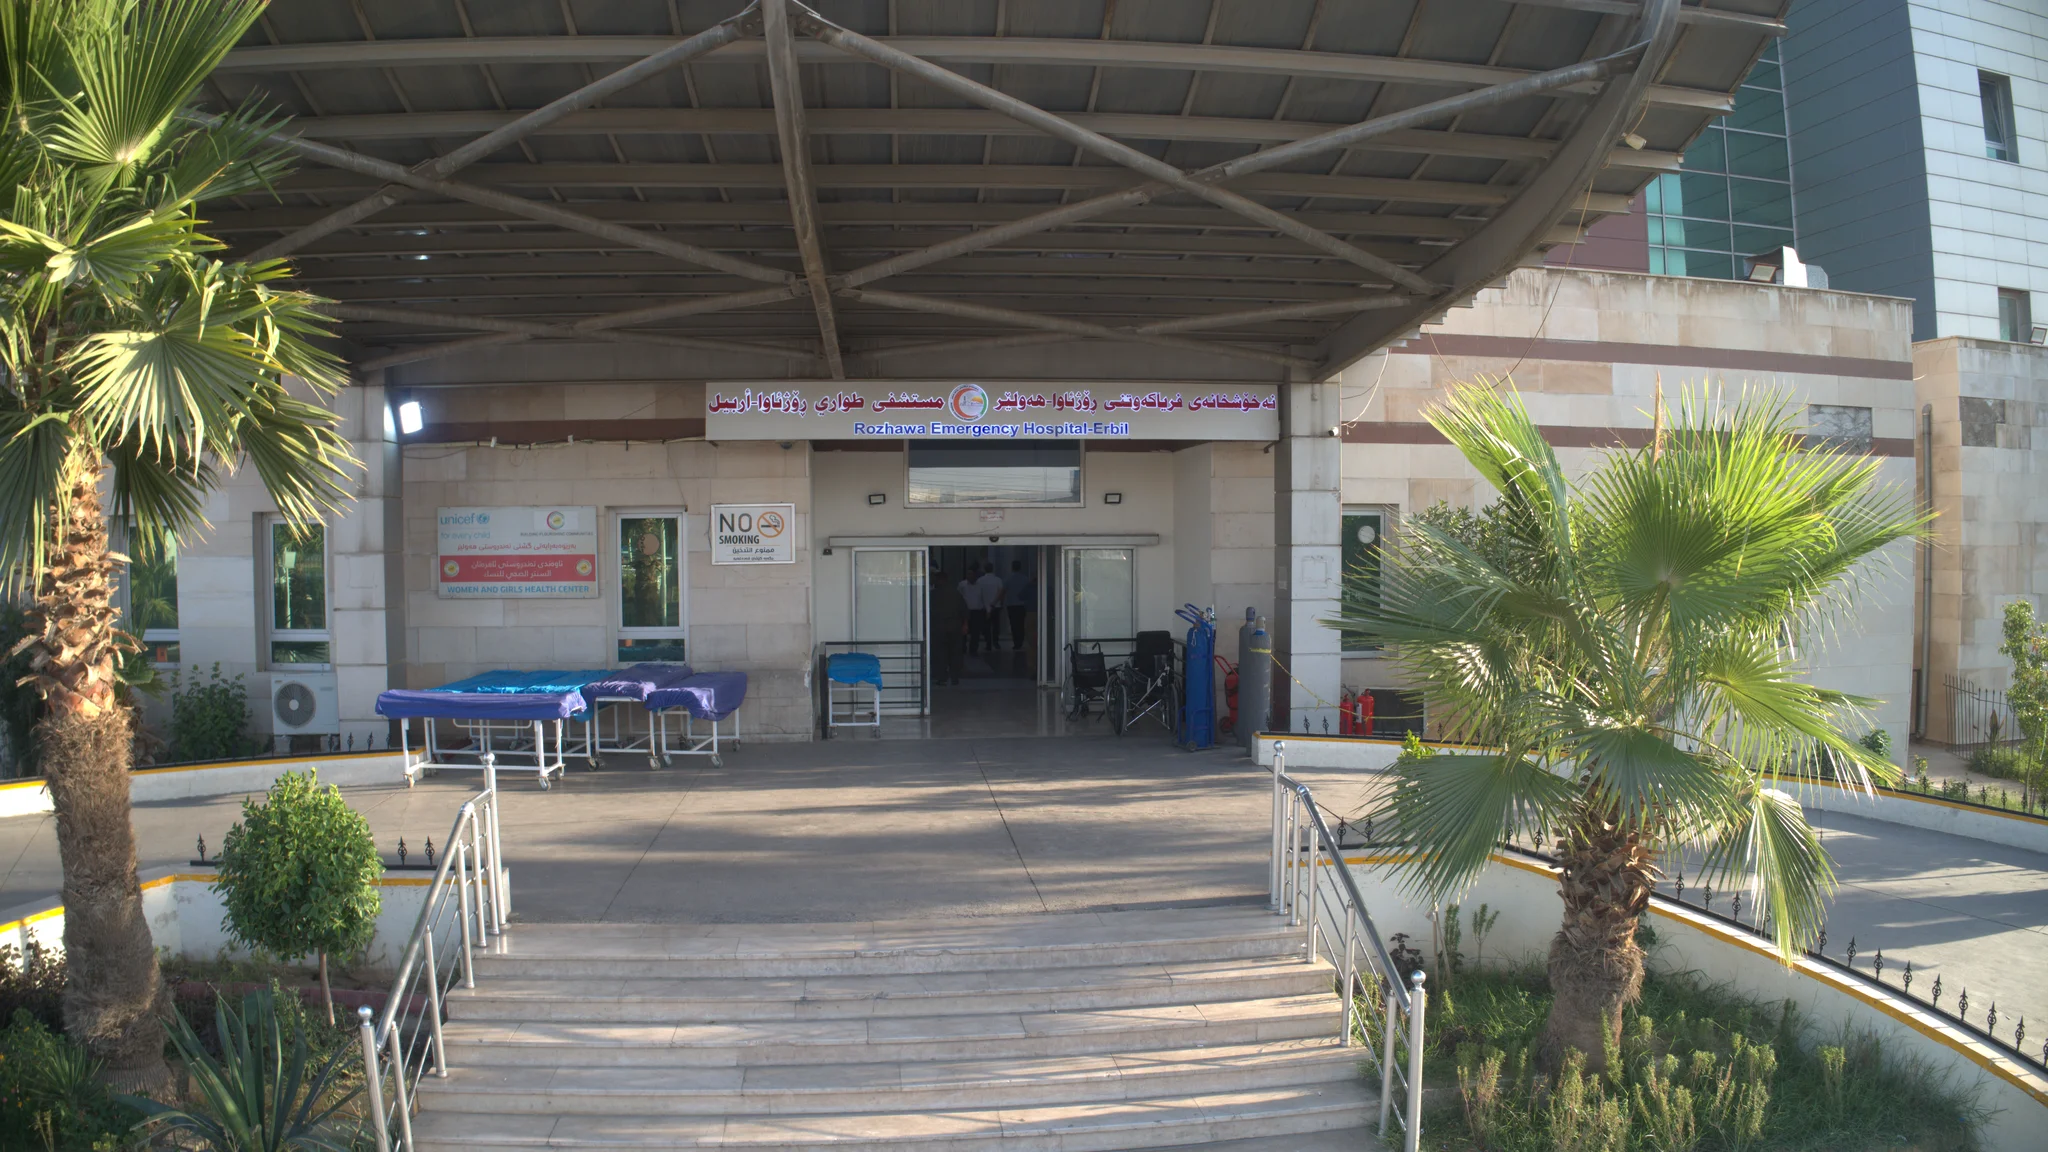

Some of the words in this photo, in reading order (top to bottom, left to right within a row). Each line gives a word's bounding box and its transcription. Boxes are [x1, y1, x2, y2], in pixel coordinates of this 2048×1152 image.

[814, 390, 865, 416] طواري
[872, 391, 945, 413] مستشفى
[853, 422, 926, 435] Rozhawa
[930, 422, 1019, 438] Emergency
[1023, 422, 1129, 438] Hospital-Erbil
[440, 513, 475, 525] unicef
[719, 513, 752, 532] NO
[453, 533, 472, 541] every
[719, 535, 760, 544] SMOKING
[447, 585, 478, 593] WOMEN
[481, 585, 498, 593] AND
[500, 585, 522, 593] GIRLS
[525, 585, 556, 593] HEALTH
[558, 585, 589, 593] CENTER
